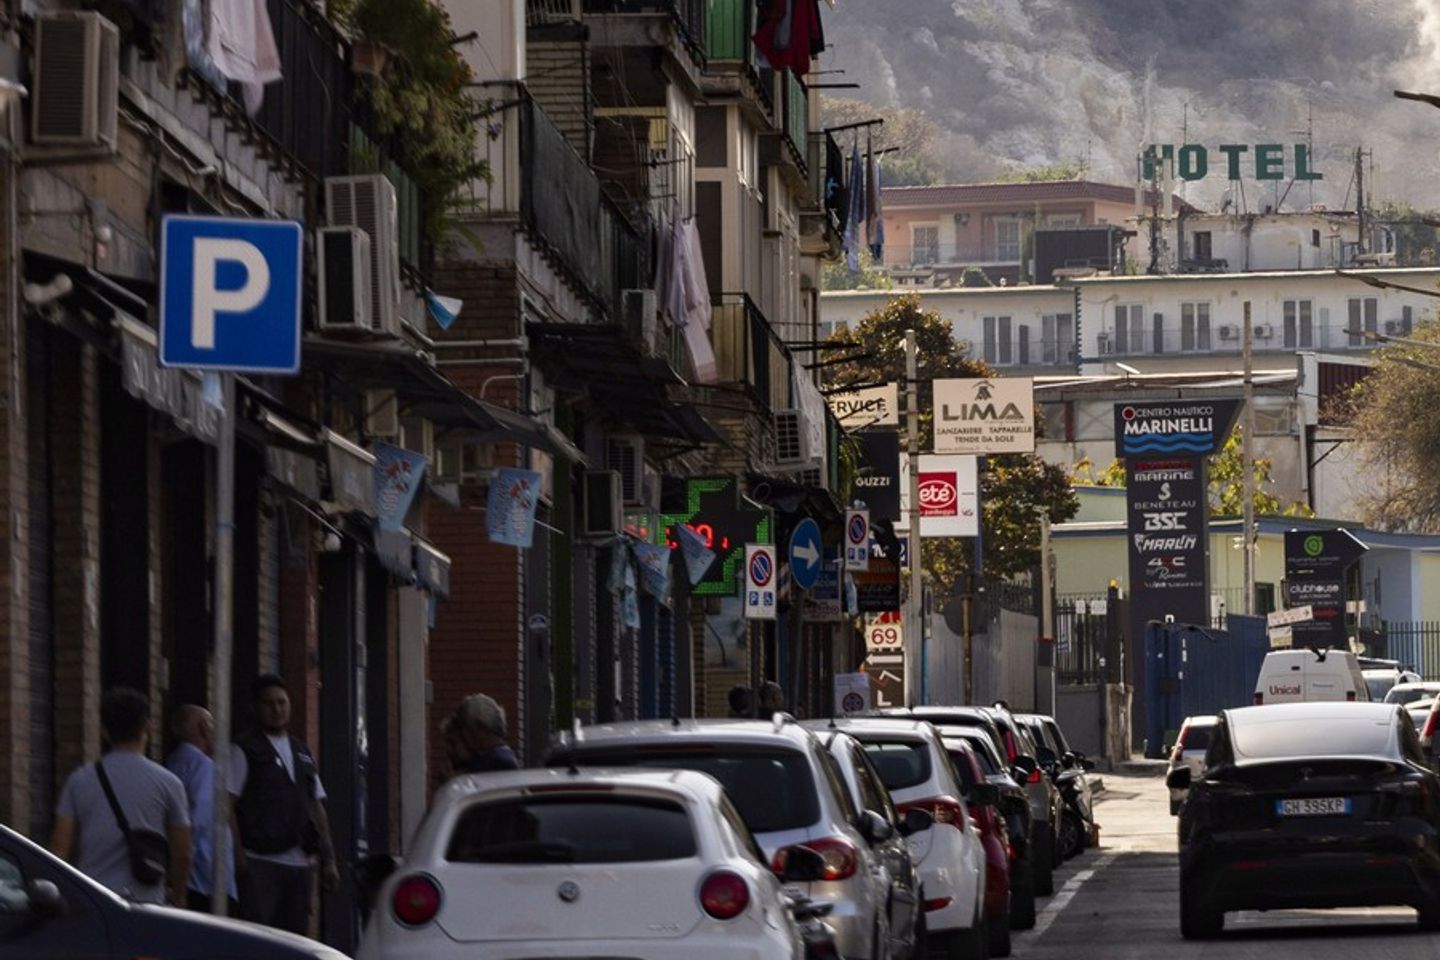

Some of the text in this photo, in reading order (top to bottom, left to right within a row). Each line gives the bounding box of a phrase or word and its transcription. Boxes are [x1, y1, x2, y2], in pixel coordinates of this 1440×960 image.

[192, 237, 270, 349] P
[828, 398, 887, 413] ERVICE
[941, 402, 1024, 422] LIMA
[1135, 405, 1214, 418] CENTRO NAUTICO
[1124, 417, 1214, 435] MARINELLI
[855, 475, 891, 488] GUZZI
[1142, 535, 1198, 551] MARLIN
[1289, 583, 1340, 594] clubhouse
[871, 627, 898, 645] 69
[1268, 684, 1302, 695] Unical
